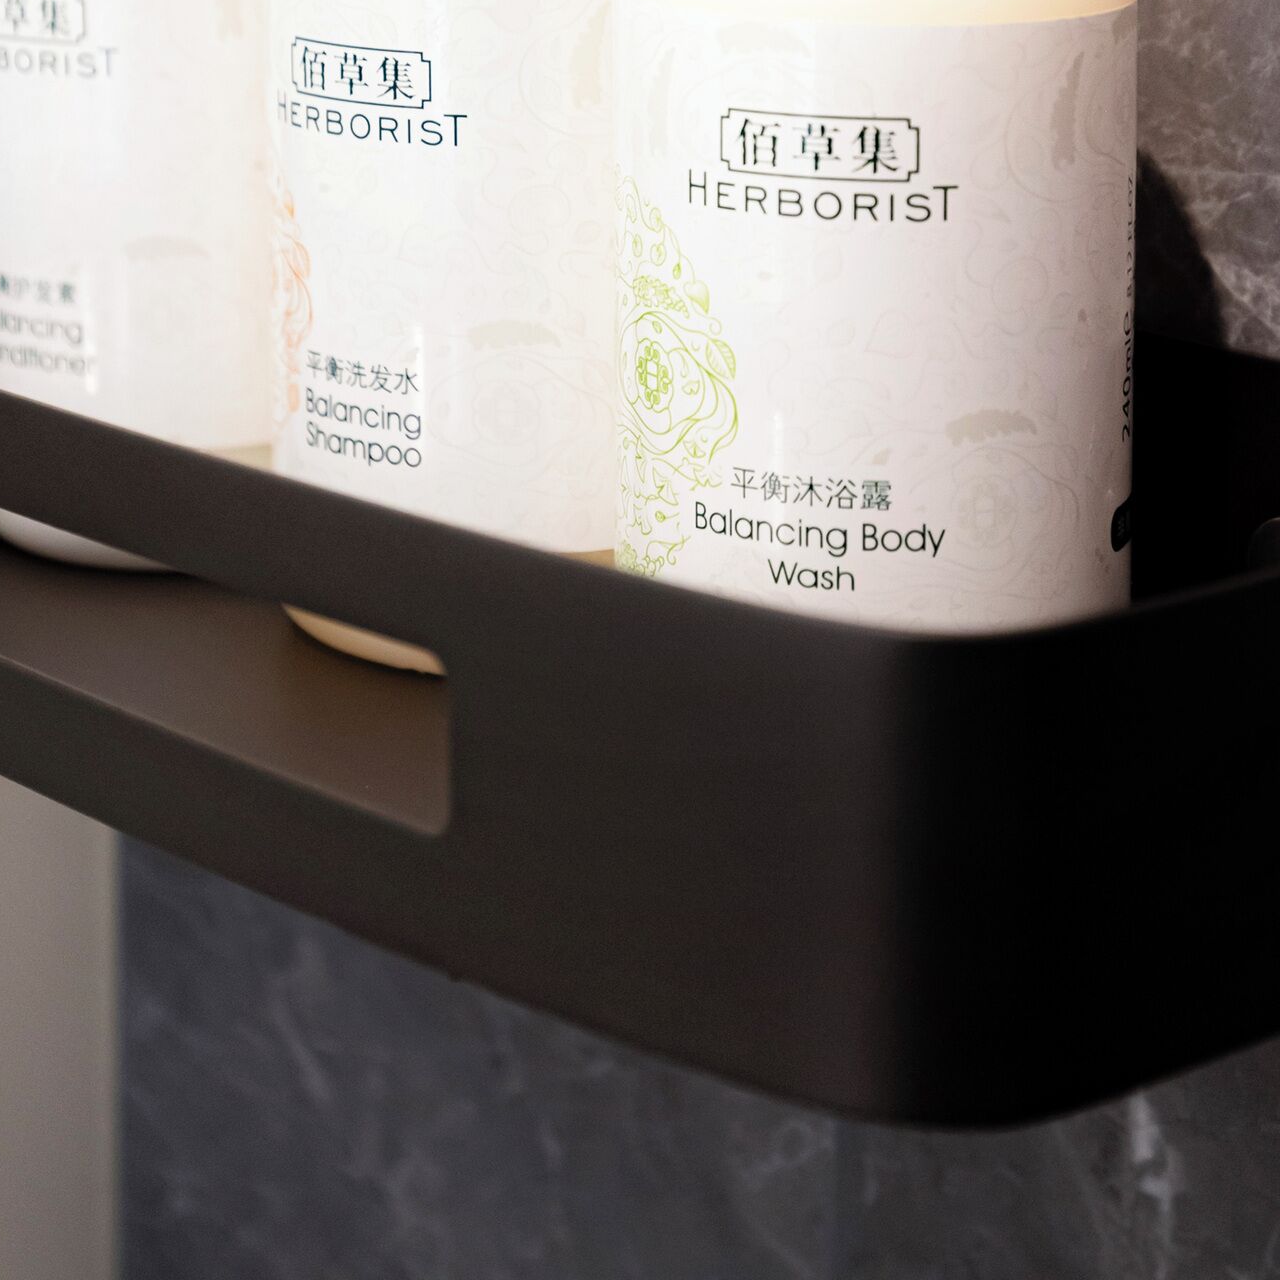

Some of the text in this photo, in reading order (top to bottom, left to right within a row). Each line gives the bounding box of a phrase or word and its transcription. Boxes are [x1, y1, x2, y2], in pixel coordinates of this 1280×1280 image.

[301, 45, 417, 101] 佰草集
[276, 87, 468, 147] HERBORIST
[736, 117, 900, 174] 佰草集
[688, 168, 960, 222] HERBORIST
[306, 349, 420, 396] 平衡洗发水
[305, 387, 422, 440] Balancing
[305, 420, 422, 468] Shampoo
[730, 466, 893, 512] 平衡沐浴露
[694, 501, 946, 558] Balancing Body
[767, 558, 856, 592] Wash
